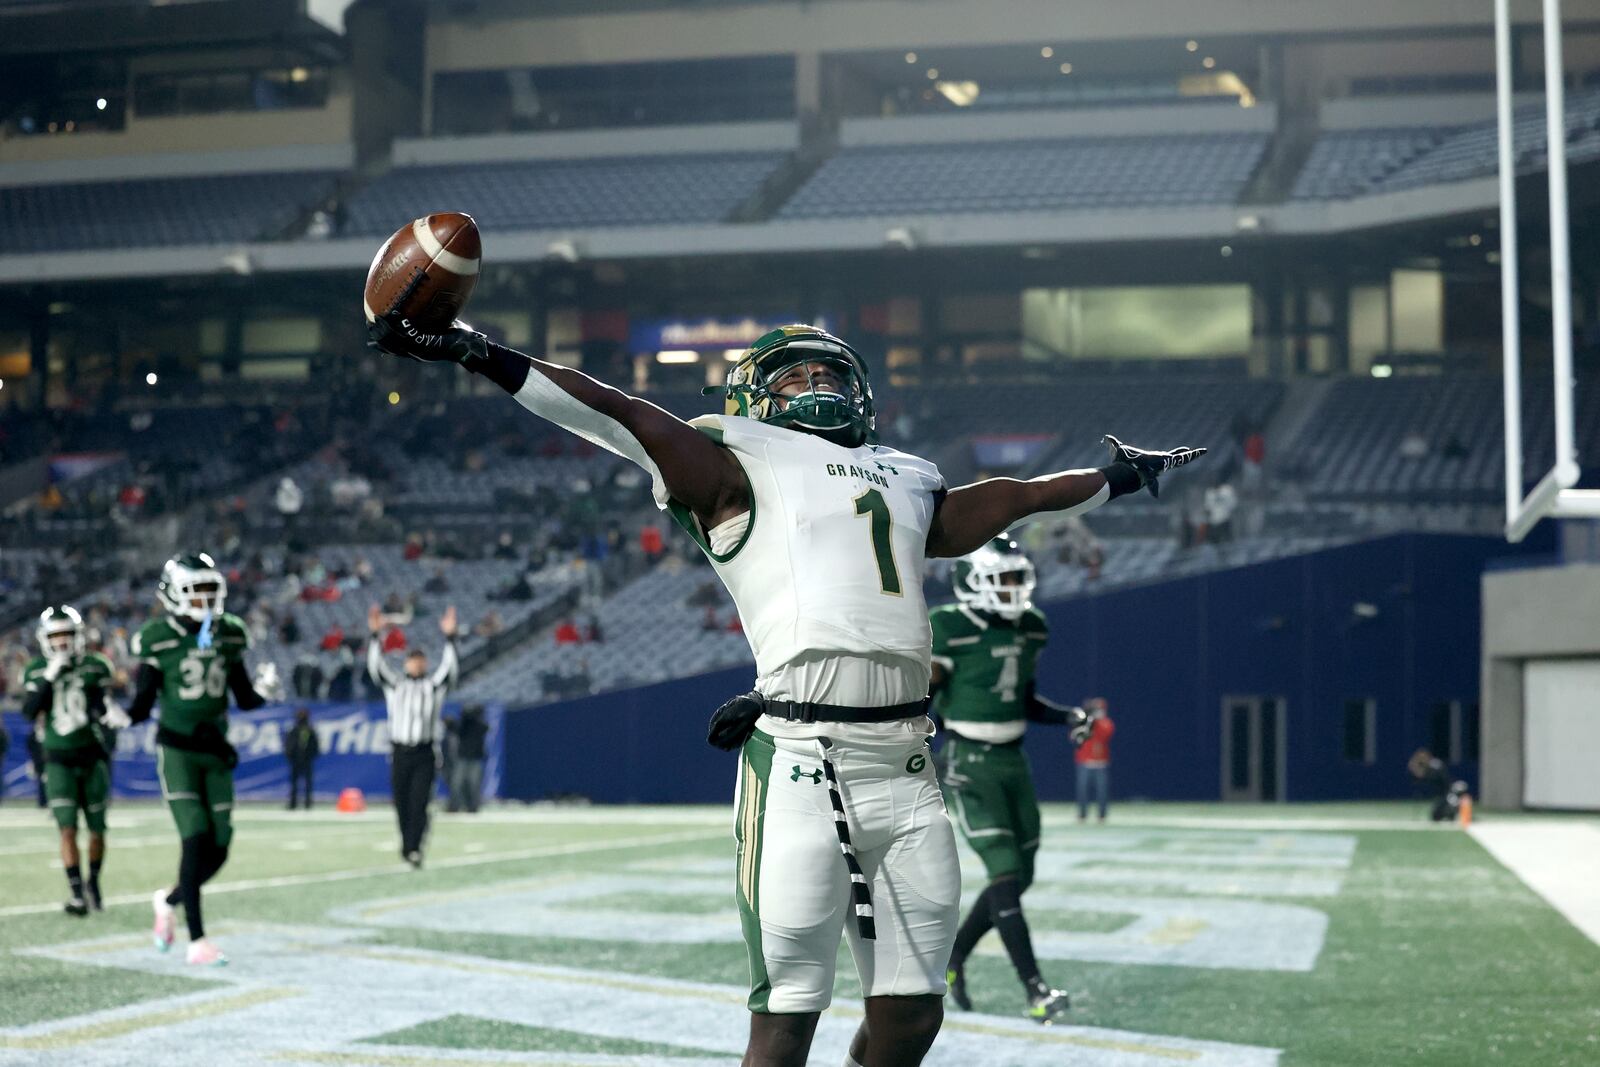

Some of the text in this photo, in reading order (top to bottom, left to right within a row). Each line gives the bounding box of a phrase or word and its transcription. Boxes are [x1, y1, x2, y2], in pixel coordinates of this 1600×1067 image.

[826, 464, 889, 489] GRAYSON
[851, 485, 904, 598] 1
[906, 753, 926, 774] G
